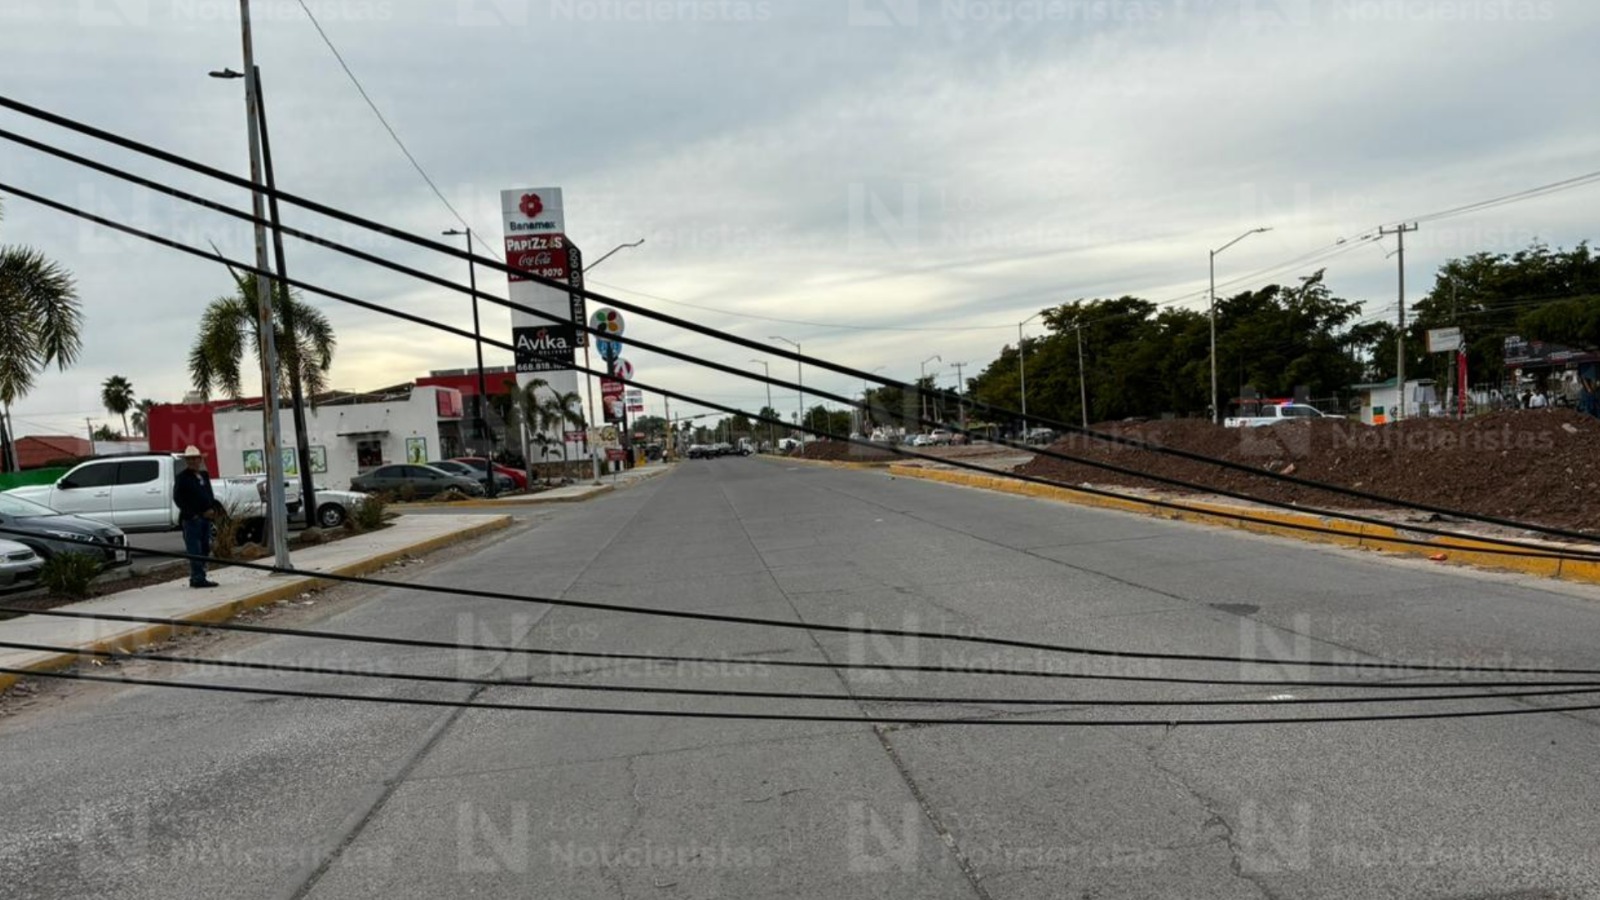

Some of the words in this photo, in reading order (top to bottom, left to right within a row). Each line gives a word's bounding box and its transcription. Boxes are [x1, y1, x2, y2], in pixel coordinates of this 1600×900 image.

[510, 221, 556, 231] Banamex
[570, 271, 584, 346] CETENRIO
[517, 333, 567, 350] Avika
